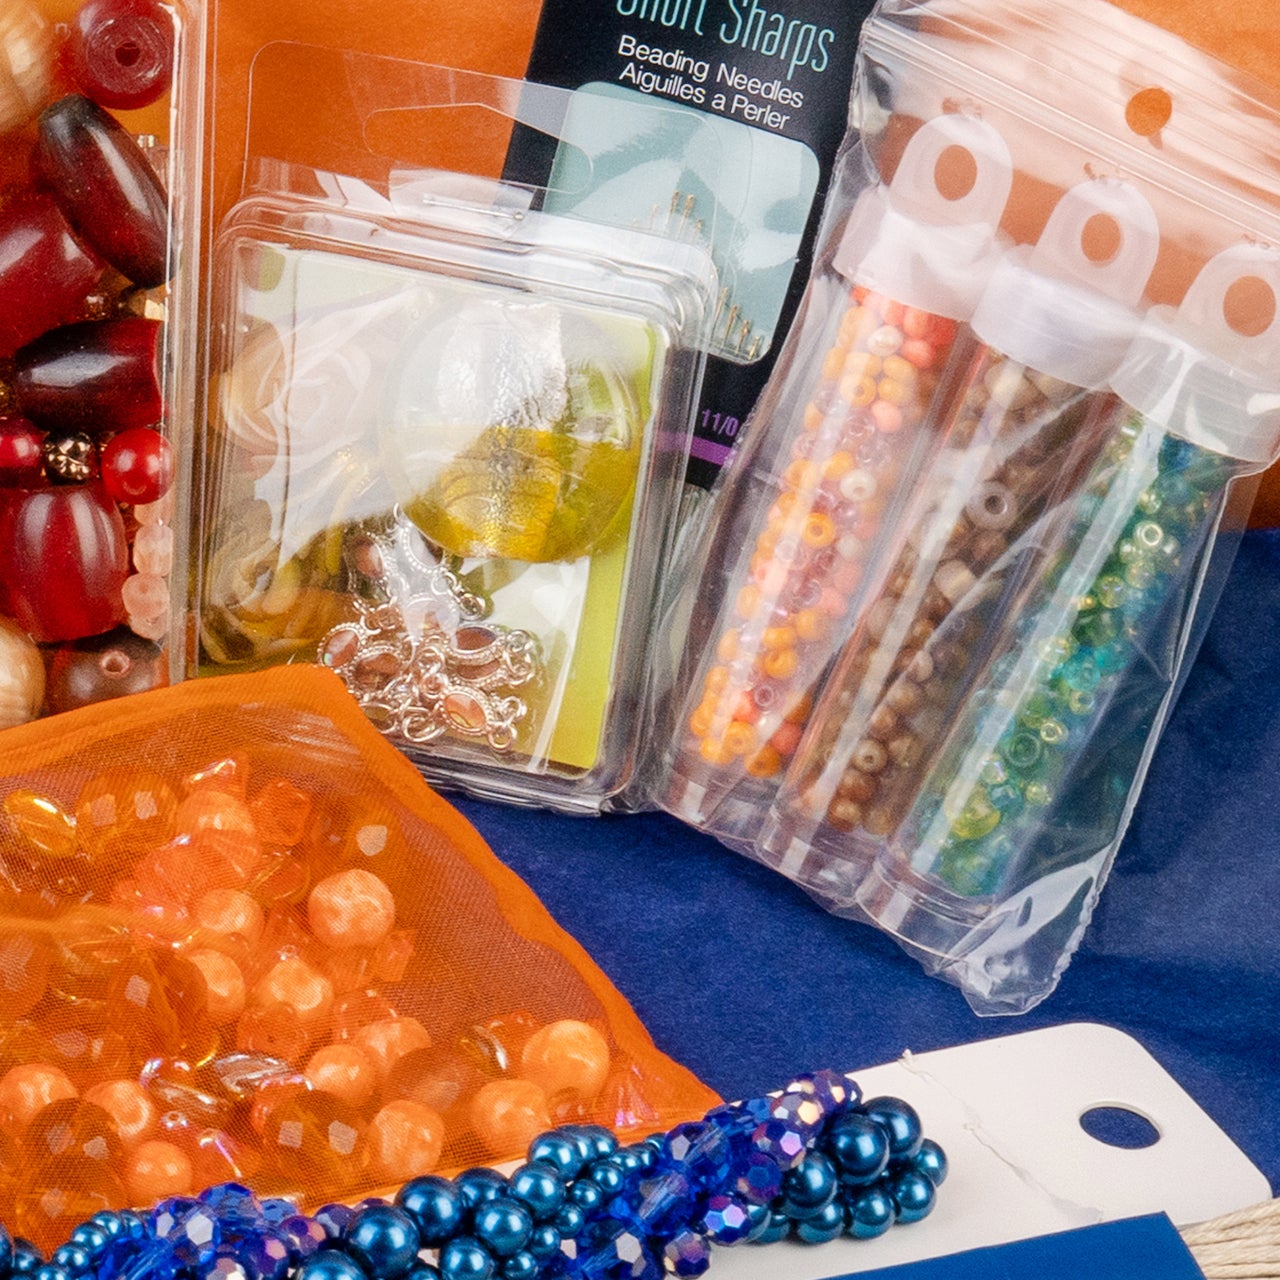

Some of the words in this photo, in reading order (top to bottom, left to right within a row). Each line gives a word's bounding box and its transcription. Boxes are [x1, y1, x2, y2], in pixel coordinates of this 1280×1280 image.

[618, 34, 710, 82] Beading
[716, 63, 804, 109] Needles
[619, 62, 707, 104] Aiguilles
[711, 93, 726, 111] a
[730, 95, 790, 130] Perler
